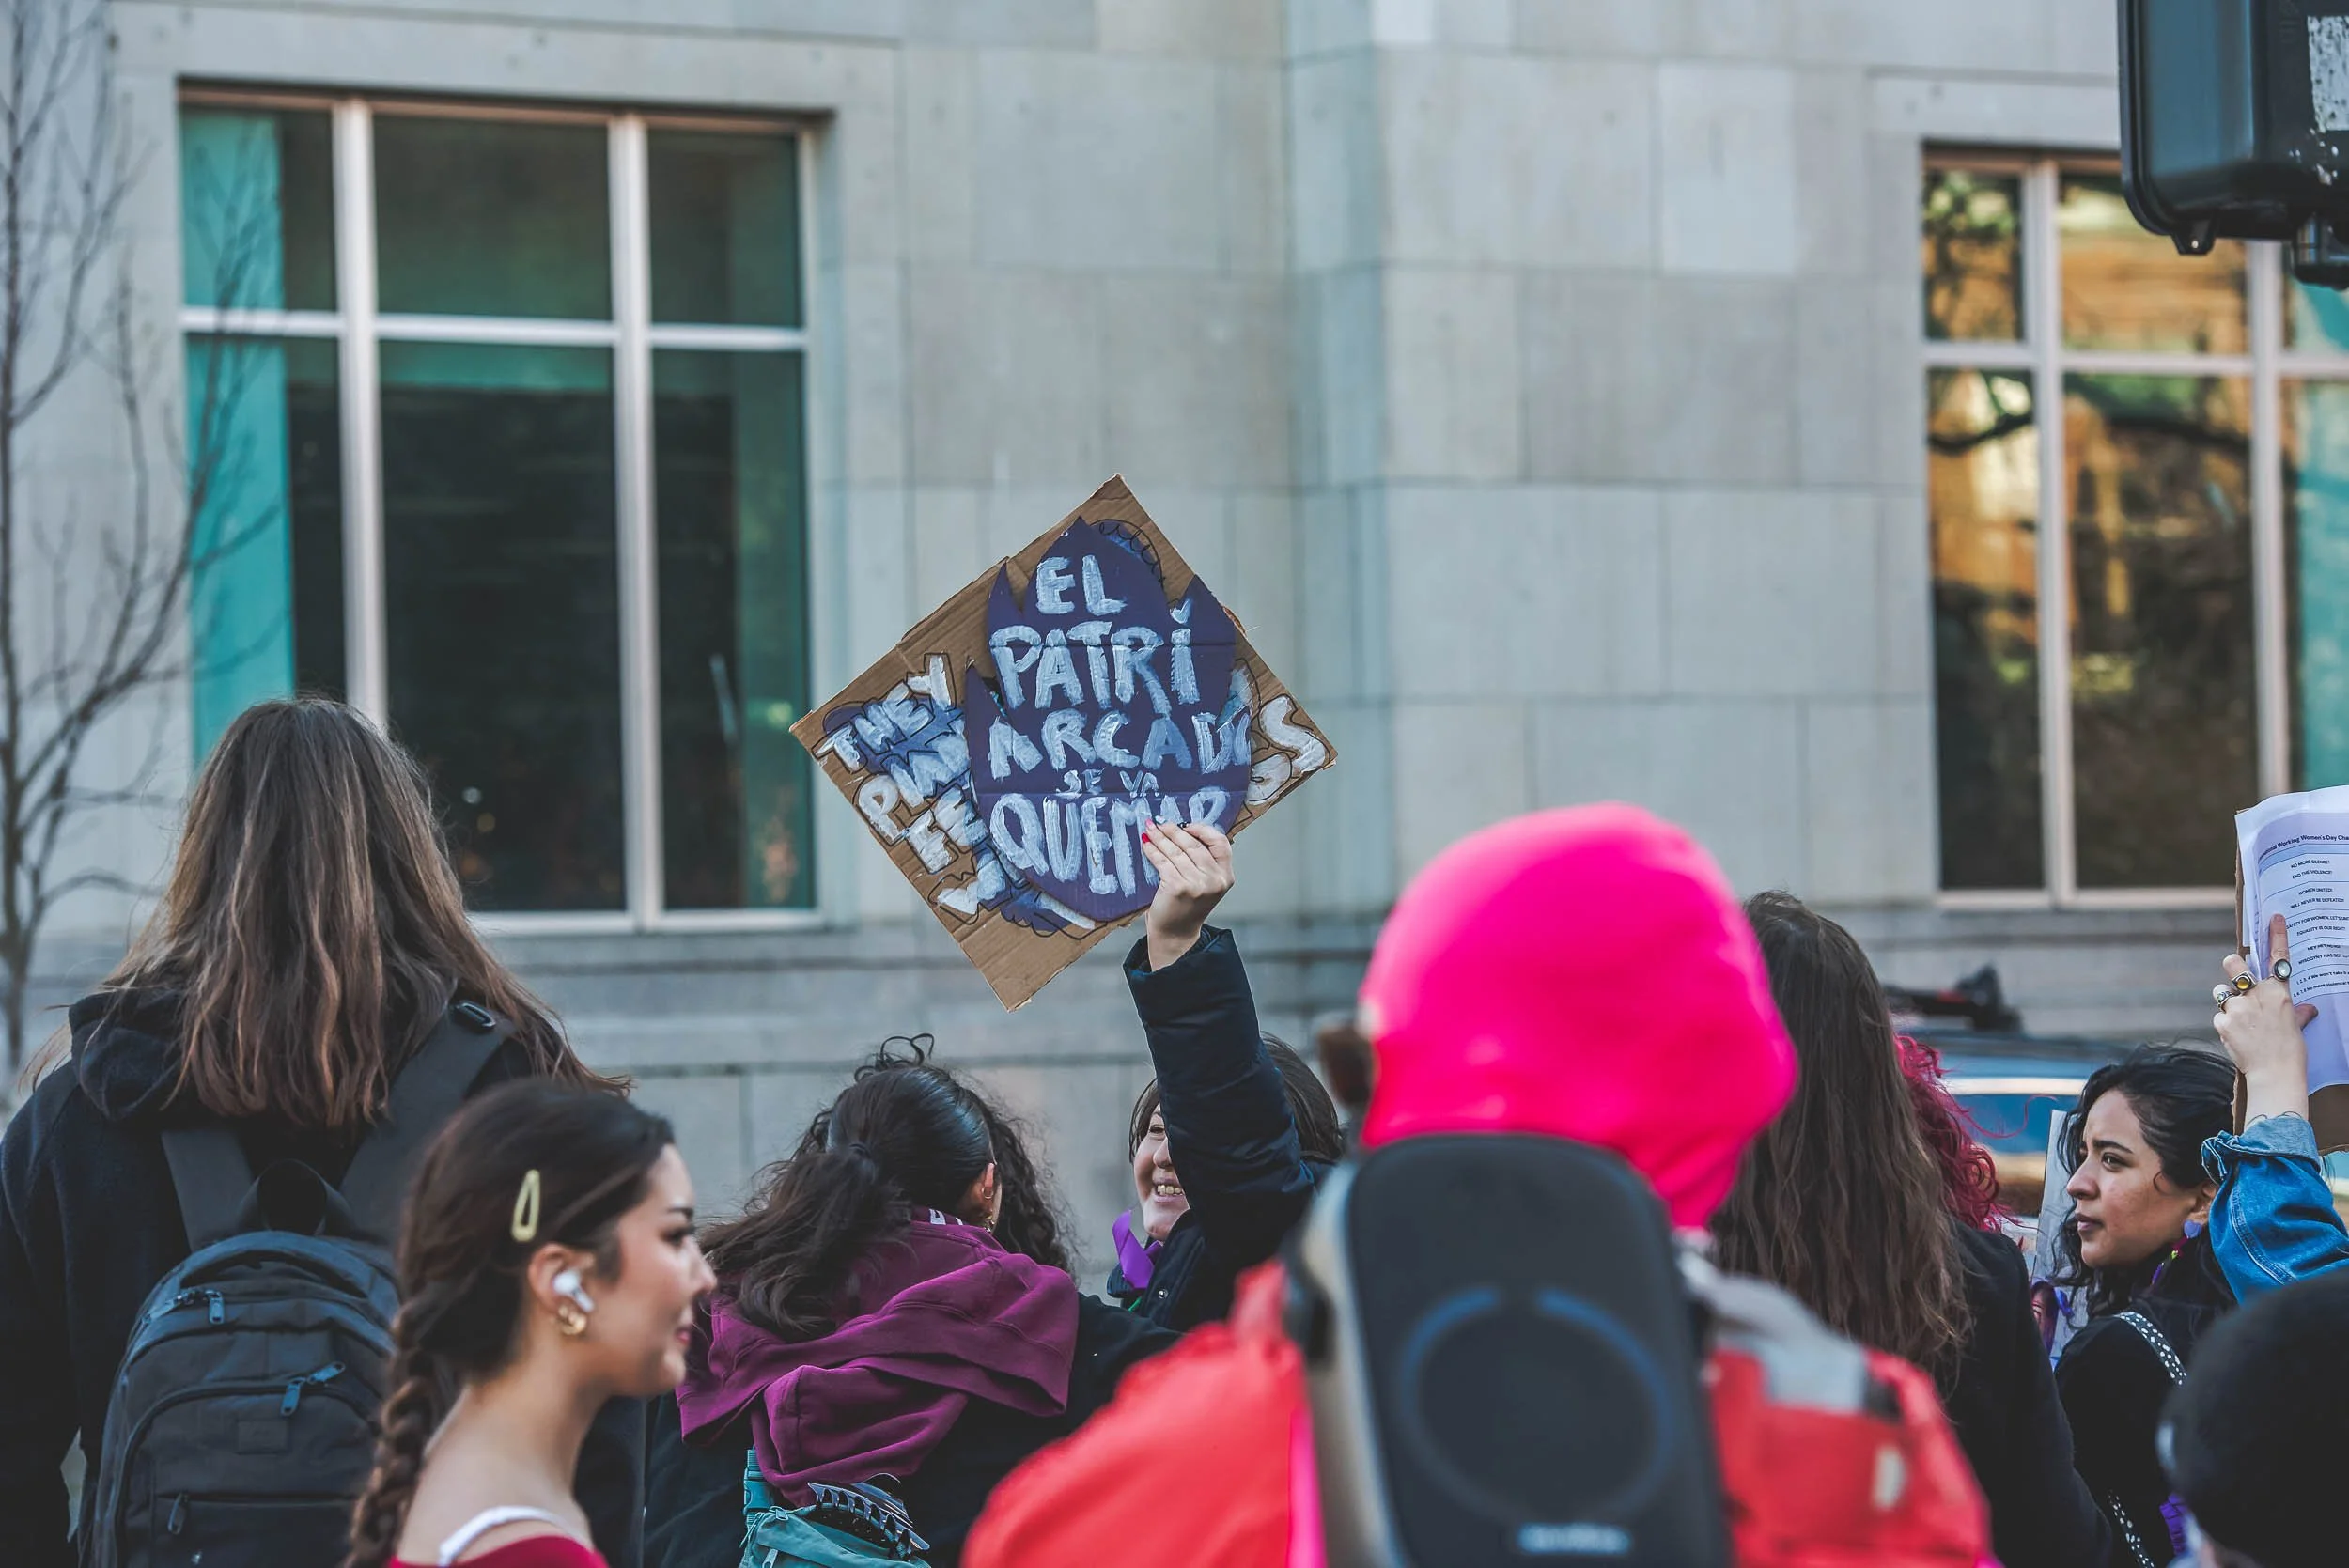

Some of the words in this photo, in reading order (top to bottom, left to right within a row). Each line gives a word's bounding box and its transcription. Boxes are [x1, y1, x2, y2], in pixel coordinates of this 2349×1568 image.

[1035, 555, 1128, 616] EL
[813, 654, 956, 773] THEY
[1056, 768, 1105, 798] SE
[1120, 770, 1160, 798] VA
[2278, 837, 2300, 847] Working
[2286, 921, 2301, 929] SAFETY
[2296, 926, 2318, 936] EQUALITY
